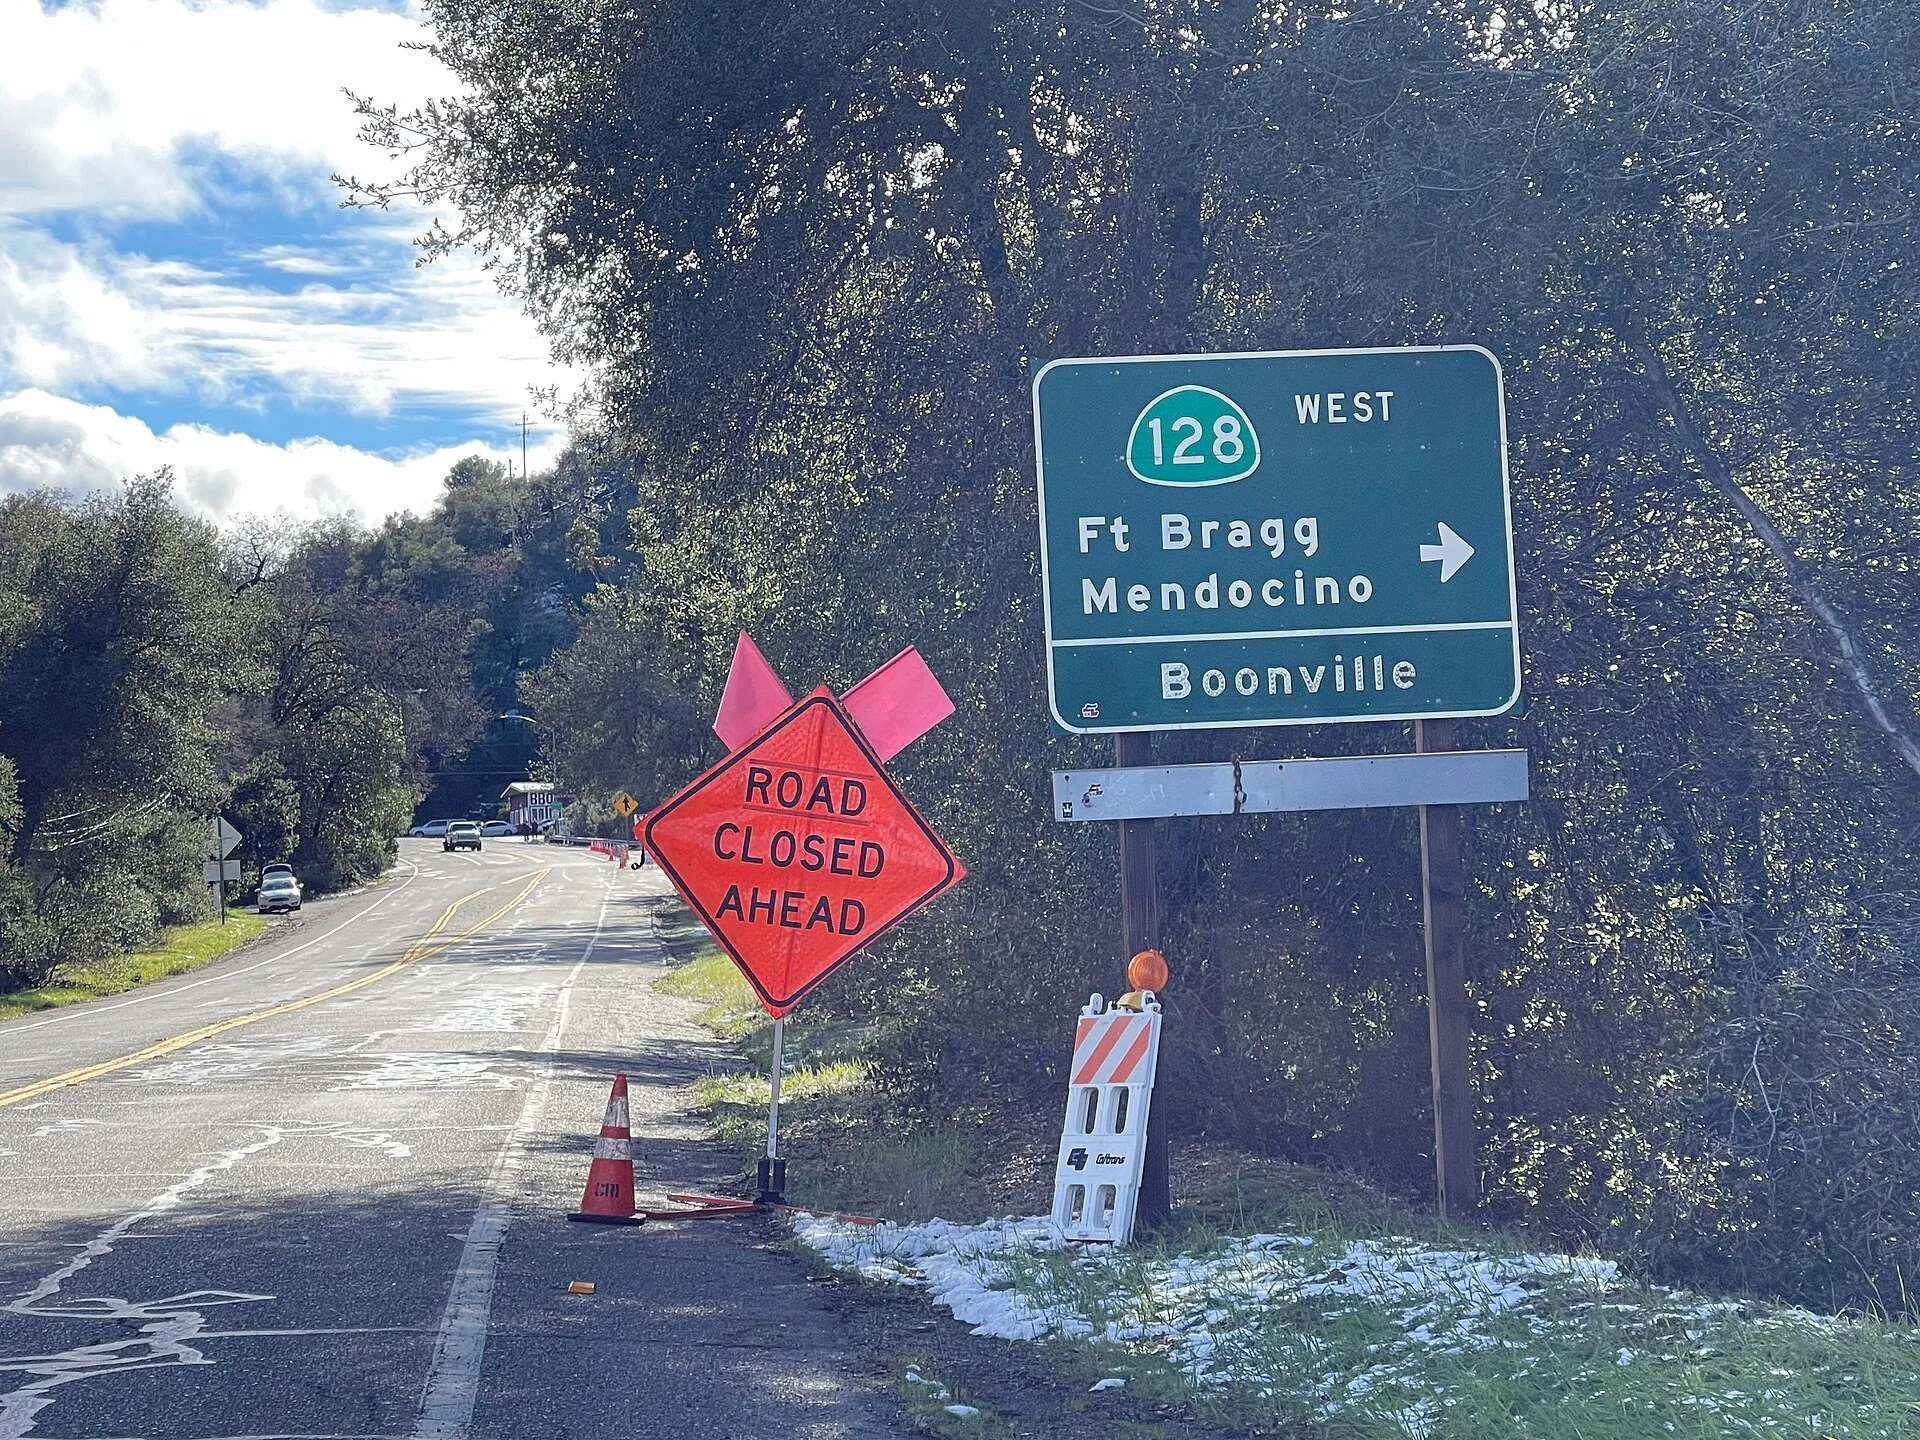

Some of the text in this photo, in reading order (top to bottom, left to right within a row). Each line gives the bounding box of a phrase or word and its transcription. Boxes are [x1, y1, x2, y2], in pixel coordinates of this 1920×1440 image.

[1294, 391, 1395, 425] WEST
[1147, 415, 1245, 466] 128
[1078, 513, 1320, 559] Ft Bragg
[1081, 569, 1374, 615] Mendocino
[1159, 654, 1417, 700] Boonville
[745, 766, 868, 817] ROAD
[714, 823, 884, 878] CLOSED
[715, 884, 867, 937] AHEAD
[1095, 1153, 1126, 1165] Caltrans
